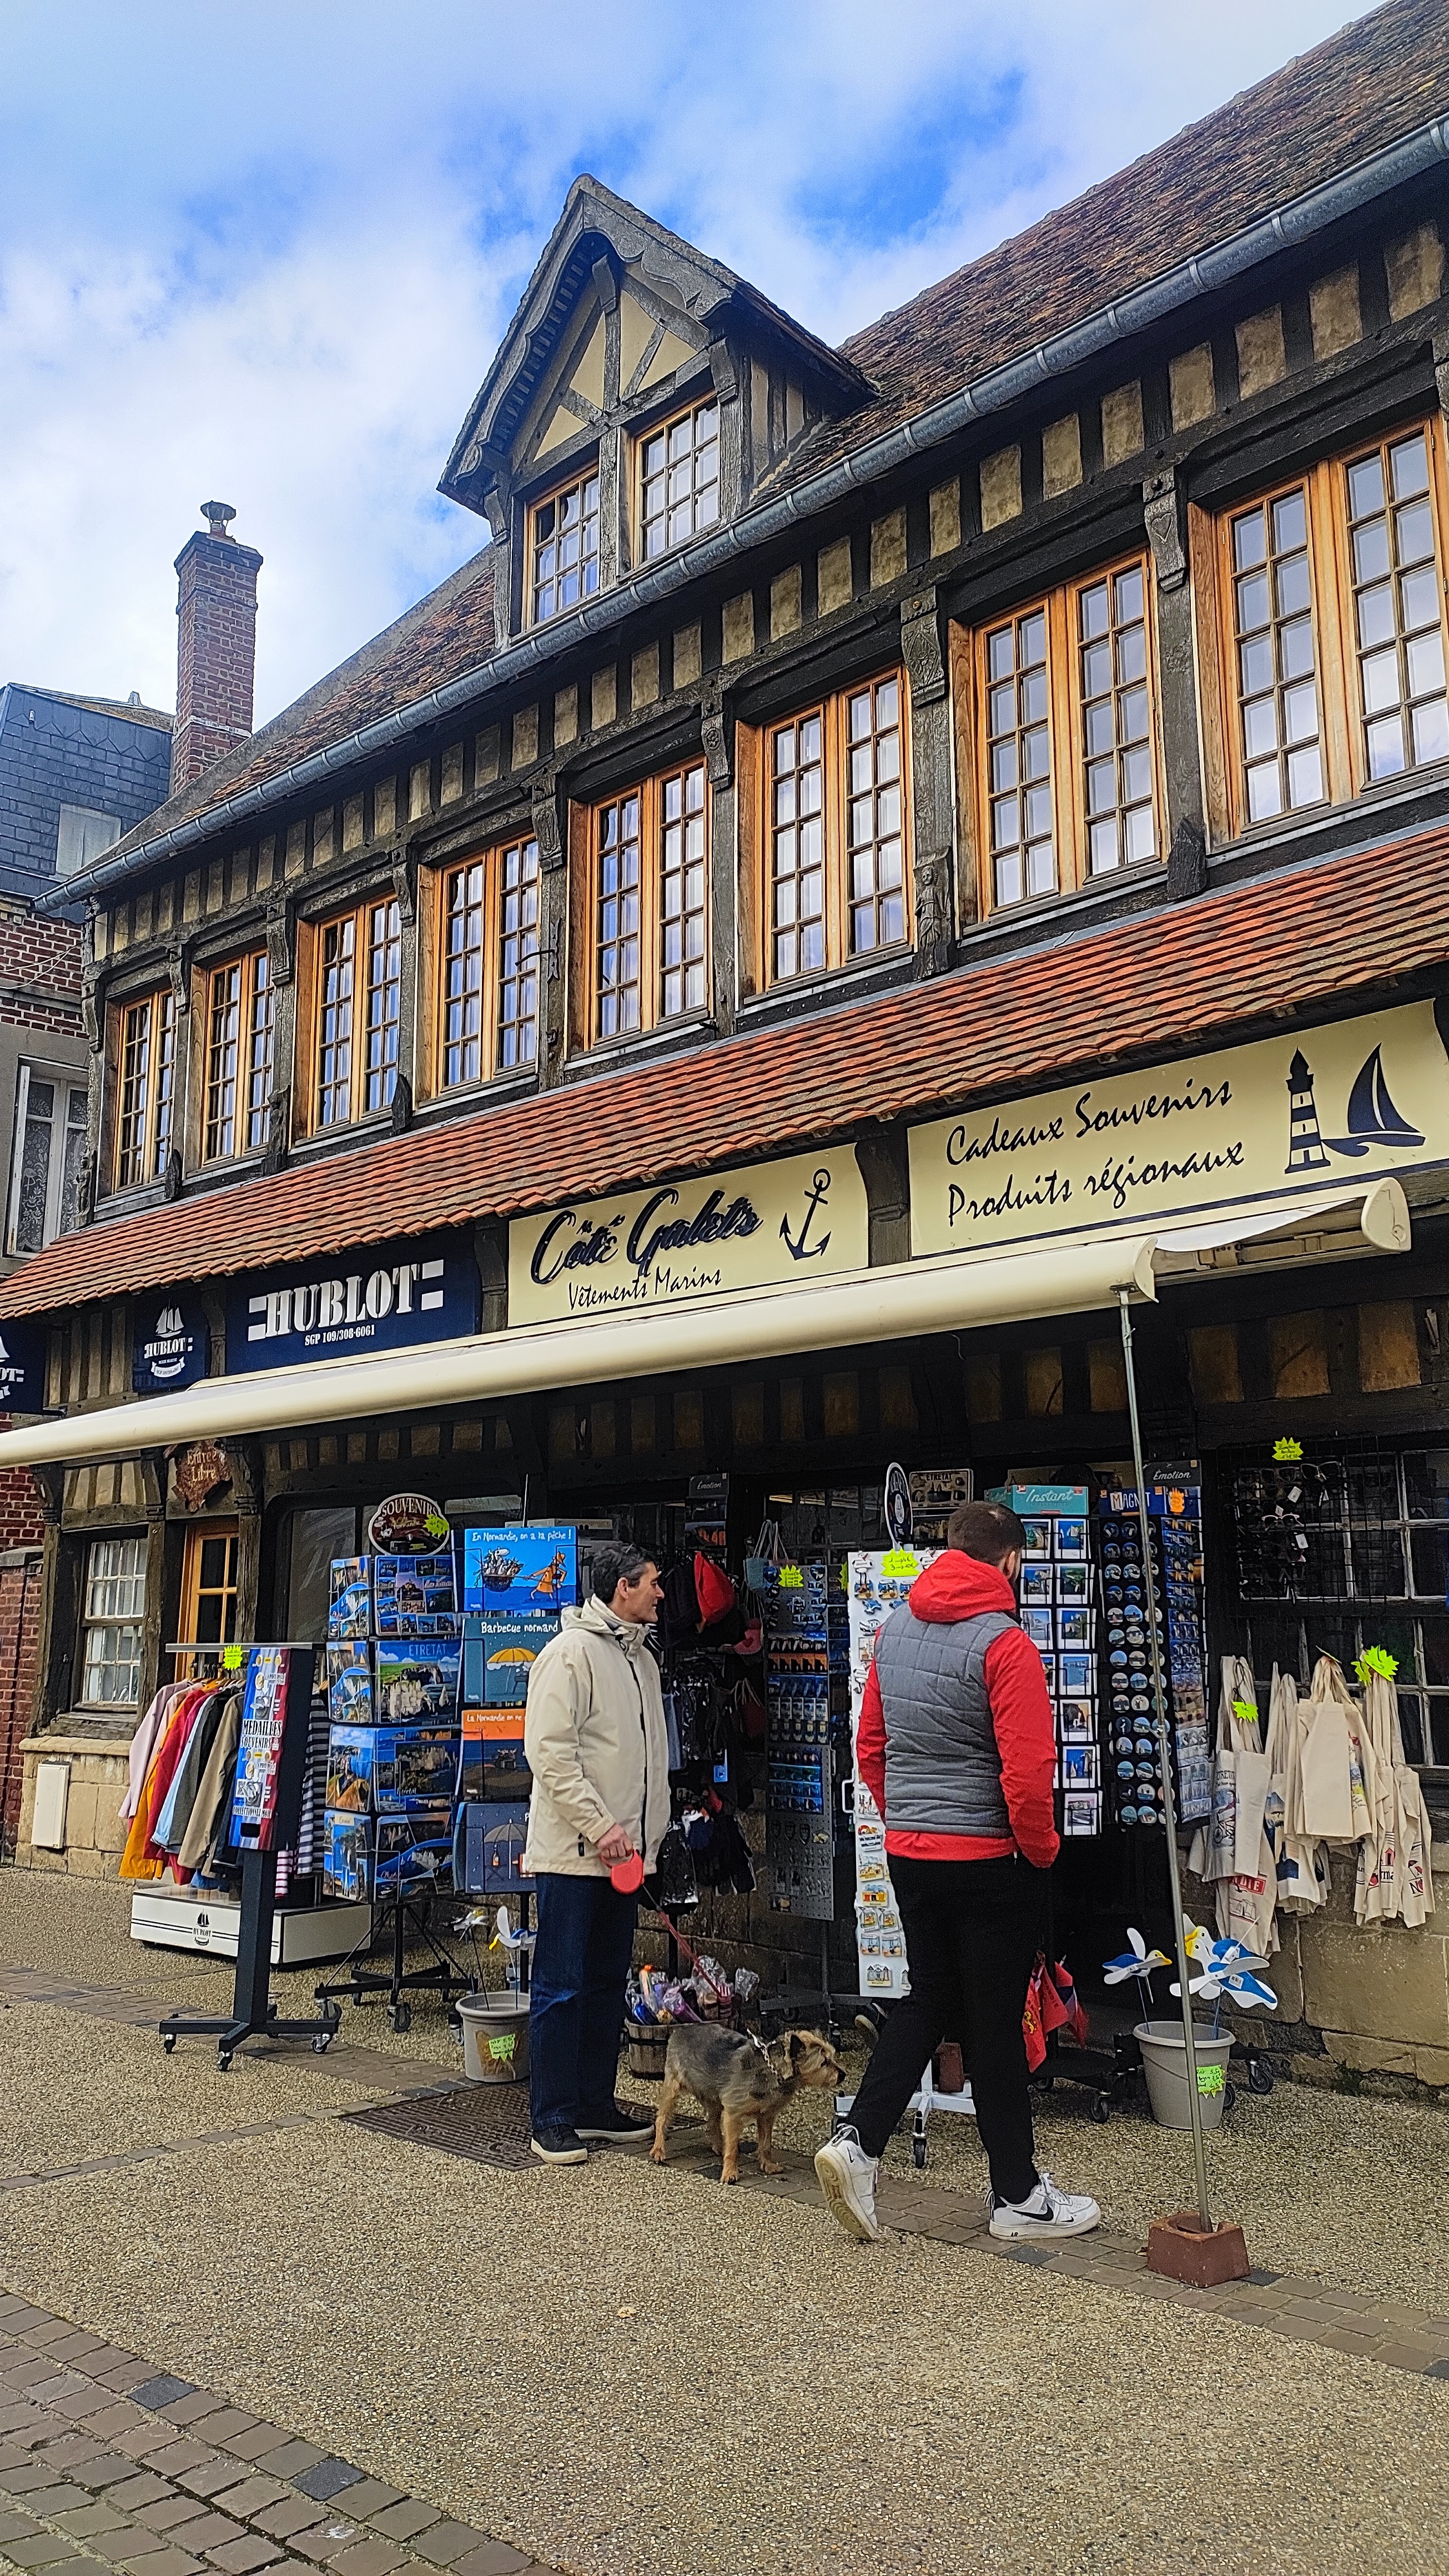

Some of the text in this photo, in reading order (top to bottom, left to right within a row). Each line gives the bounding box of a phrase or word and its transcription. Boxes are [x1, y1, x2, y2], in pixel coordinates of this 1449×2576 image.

[945, 1078, 1233, 1166] Cadeaux Souvenirs
[948, 1141, 1245, 1227] Produits régionaux
[626, 1188, 763, 1277] Galets
[568, 1266, 722, 1310] Vêtements Marins
[265, 1264, 420, 1337] HUBLOT
[146, 1337, 186, 1357] HUBLOT
[305, 1333, 320, 1346] SGP
[192, 1463, 217, 1482] Libre
[926, 1473, 952, 1481] ETRETAT
[1026, 1489, 1074, 1502] Instant
[1112, 1492, 1150, 1510] MAGNT
[382, 1497, 437, 1517] SOUVENIRS
[472, 1532, 481, 1542] En
[538, 1531, 545, 1540] la
[547, 1530, 566, 1542] pêche
[481, 1620, 558, 1634] Barbecue normand
[409, 1644, 446, 1656] ETRETAT
[467, 1714, 475, 1722] La
[476, 1713, 505, 1722] Normandie
[243, 1720, 281, 1737] MEDAILLES
[241, 1735, 271, 1748] SOUVENIRS
[193, 1928, 212, 1937] HUBLOT
